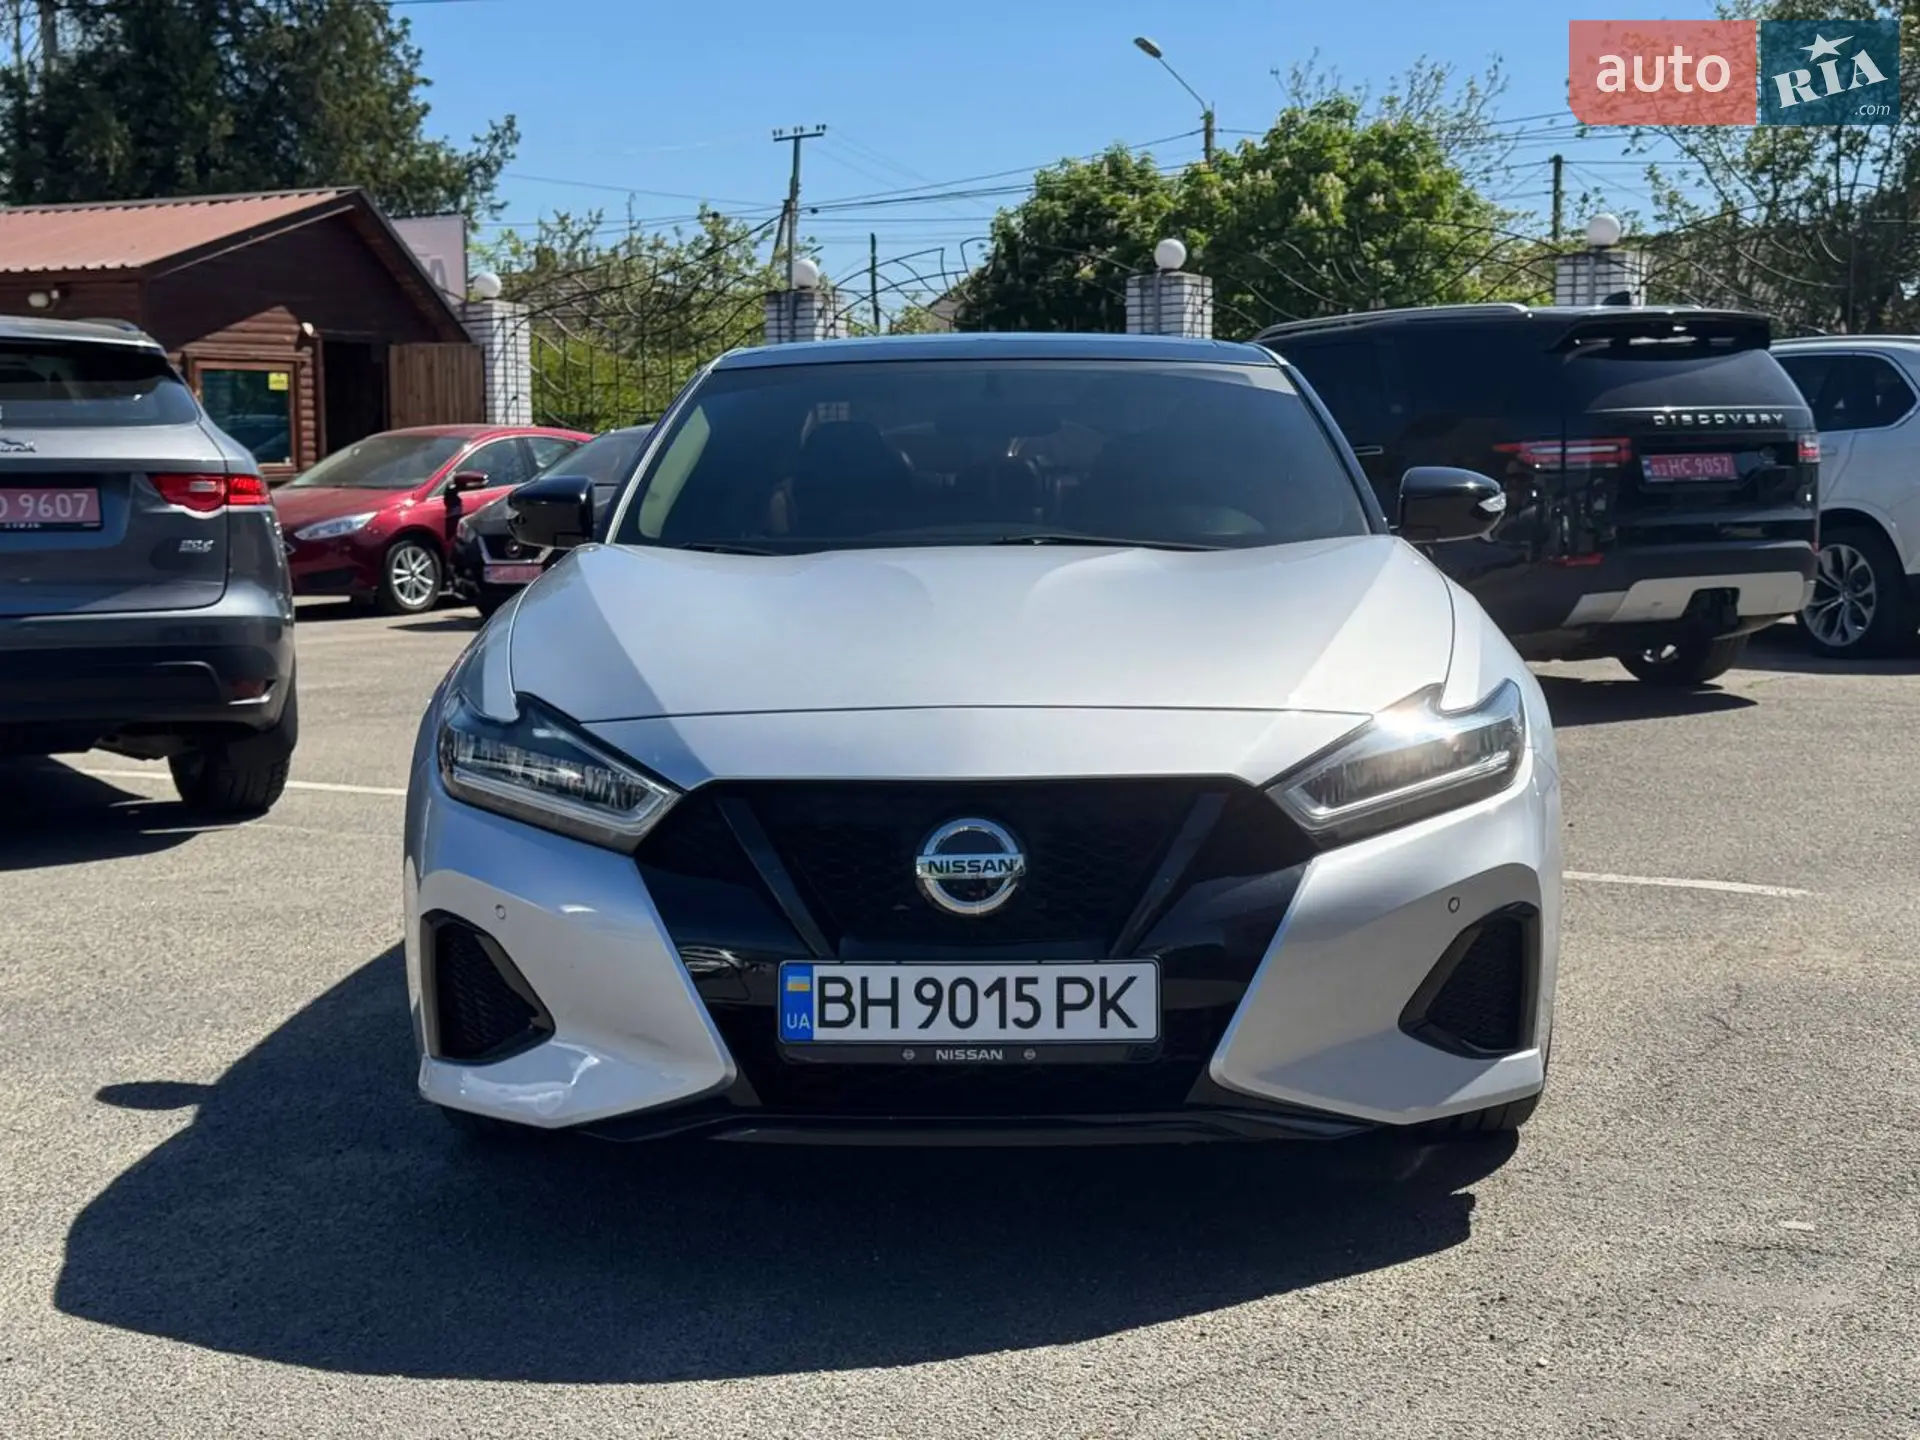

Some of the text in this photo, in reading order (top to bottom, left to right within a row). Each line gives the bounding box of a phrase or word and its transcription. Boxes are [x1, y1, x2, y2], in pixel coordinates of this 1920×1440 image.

[1653, 413, 1783, 426] DISCOVERY
[1693, 456, 1730, 475] 9057
[18, 493, 89, 518] 9607
[928, 858, 1014, 874] NISSAN
[817, 976, 1139, 1029] BH 9015 PK
[786, 1014, 811, 1030] UA
[935, 1049, 1003, 1061] NISSAN
